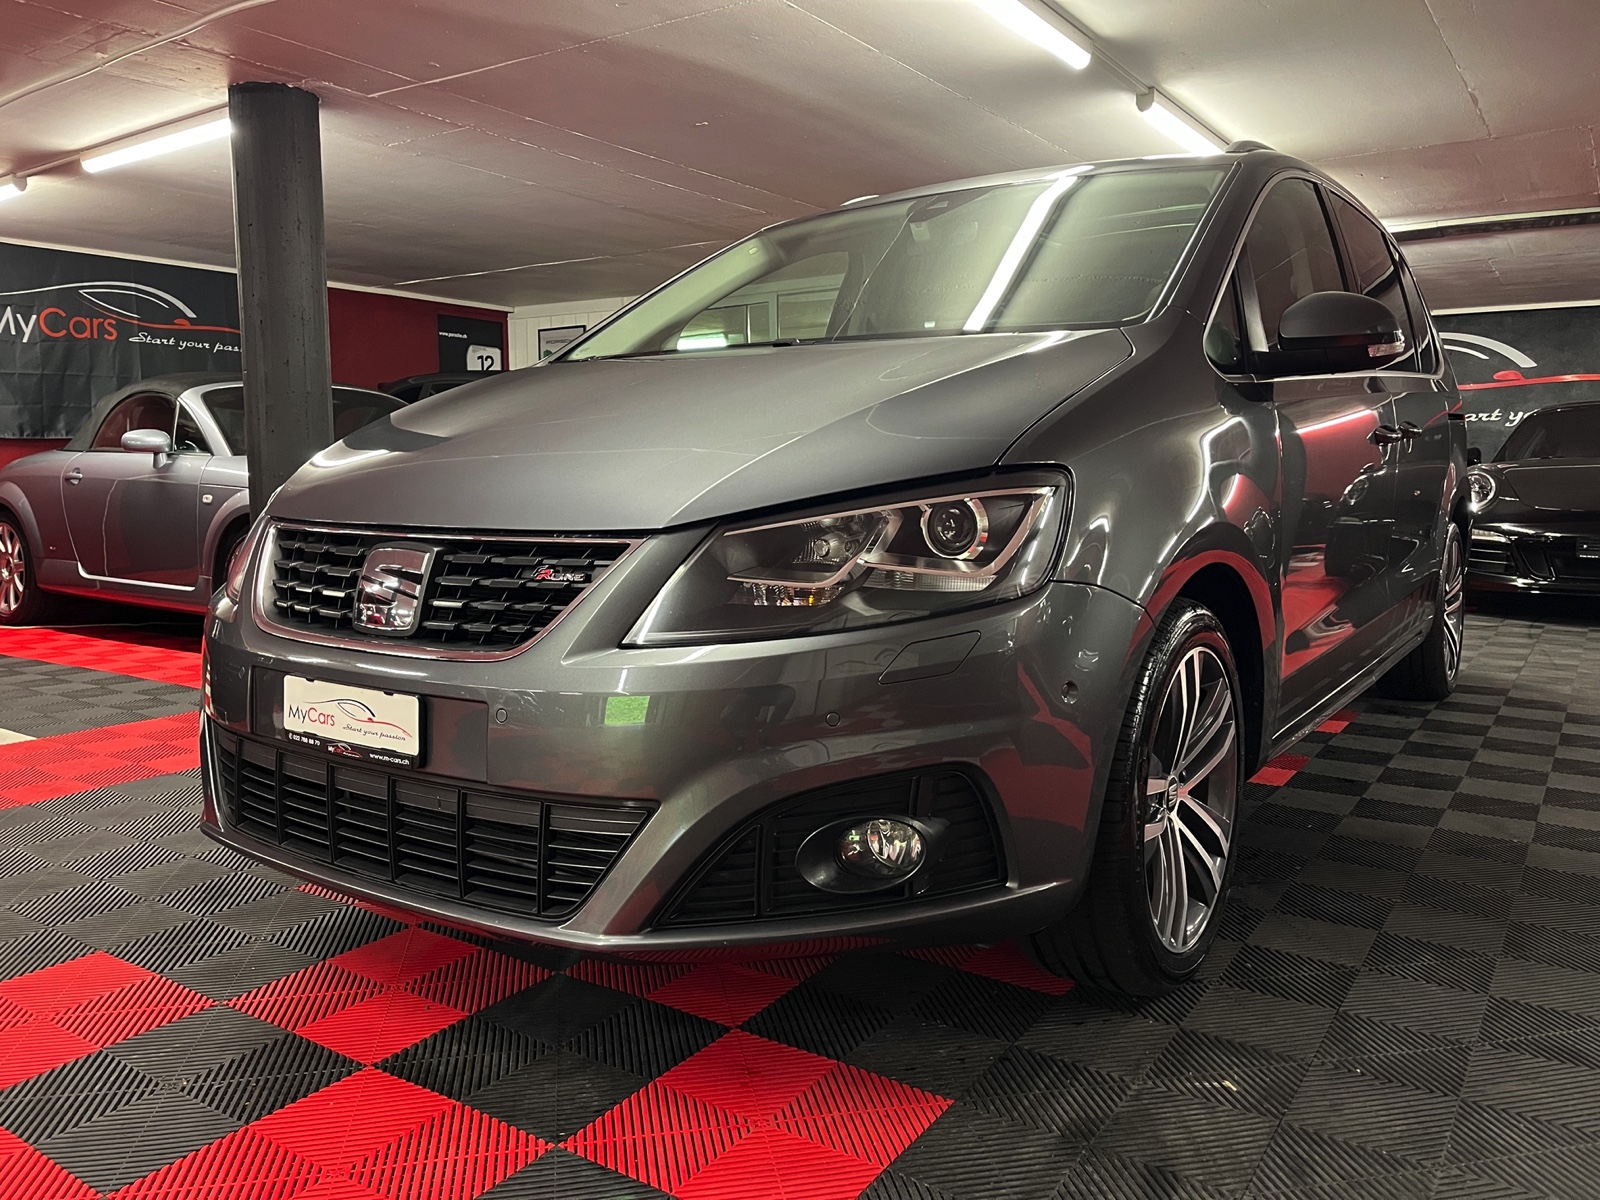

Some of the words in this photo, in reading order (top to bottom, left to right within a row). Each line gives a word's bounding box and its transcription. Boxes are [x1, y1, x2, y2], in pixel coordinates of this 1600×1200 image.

[0, 305, 118, 343] MyCars
[129, 332, 176, 345] Start
[178, 340, 210, 350] your
[213, 342, 242, 353] pas
[476, 354, 495, 371] 12
[1465, 408, 1503, 421] art
[288, 703, 336, 727] MyCars
[343, 723, 362, 733] Start
[379, 731, 406, 741] passion
